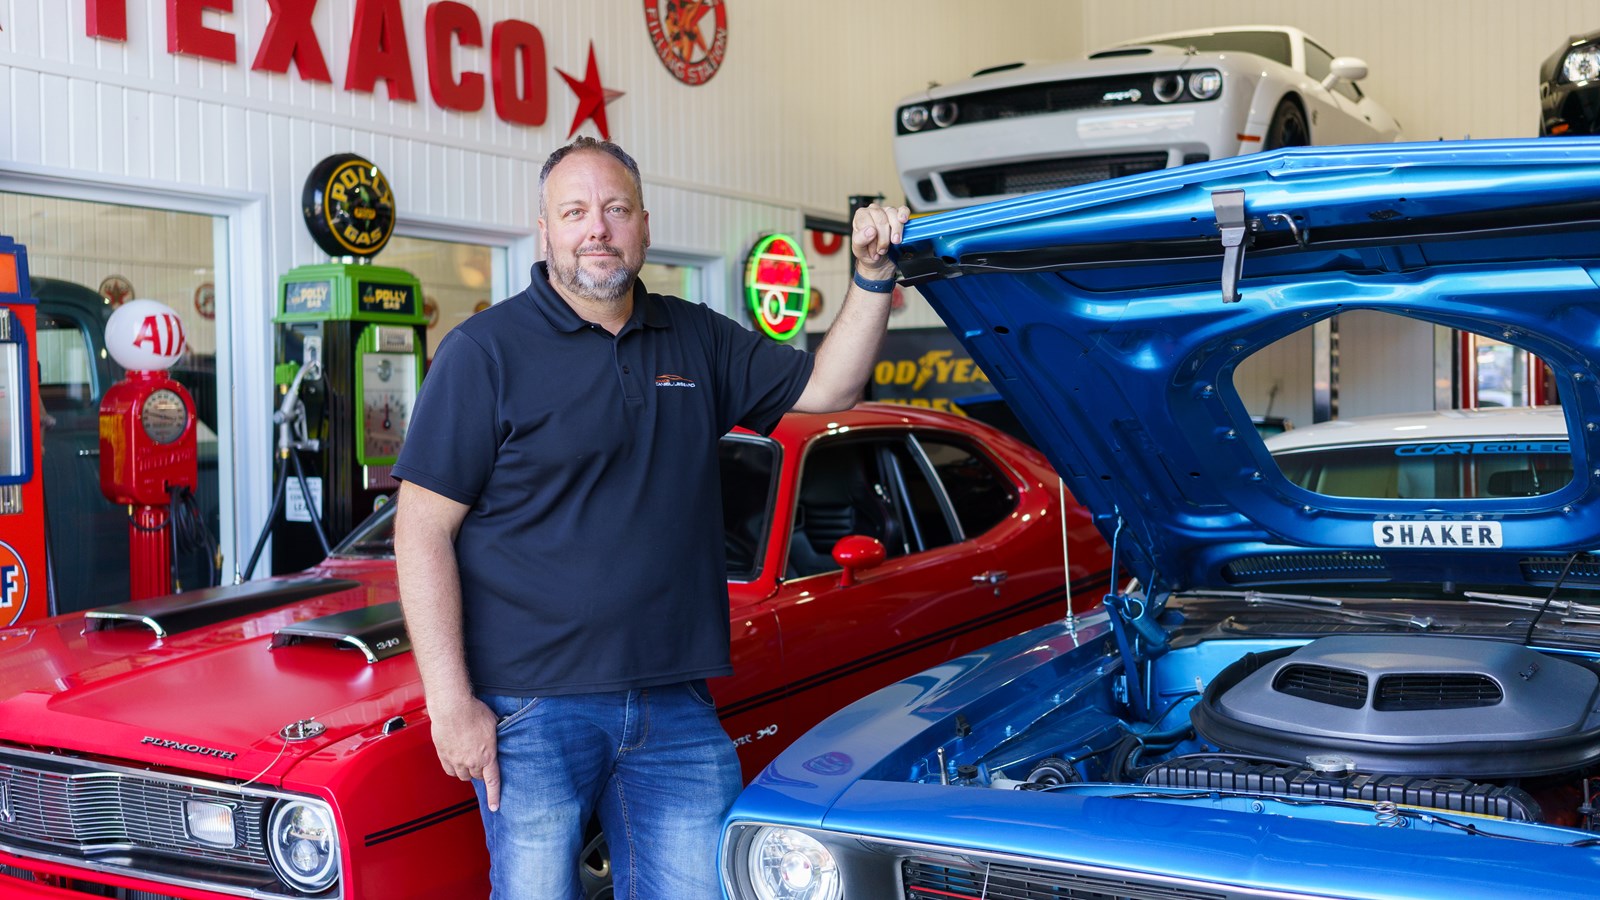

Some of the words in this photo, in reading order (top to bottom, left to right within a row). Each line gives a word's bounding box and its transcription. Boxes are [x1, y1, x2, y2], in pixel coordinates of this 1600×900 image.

[331, 167, 391, 207] POLLY
[343, 225, 382, 245] GAS
[300, 285, 329, 303] POLLY
[374, 288, 408, 304] POLLY
[383, 301, 401, 310] GAS
[1382, 524, 1496, 546] SHAKER
[376, 637, 400, 650] 340
[756, 723, 778, 740] 340
[141, 736, 237, 761] PLYMOUTH
